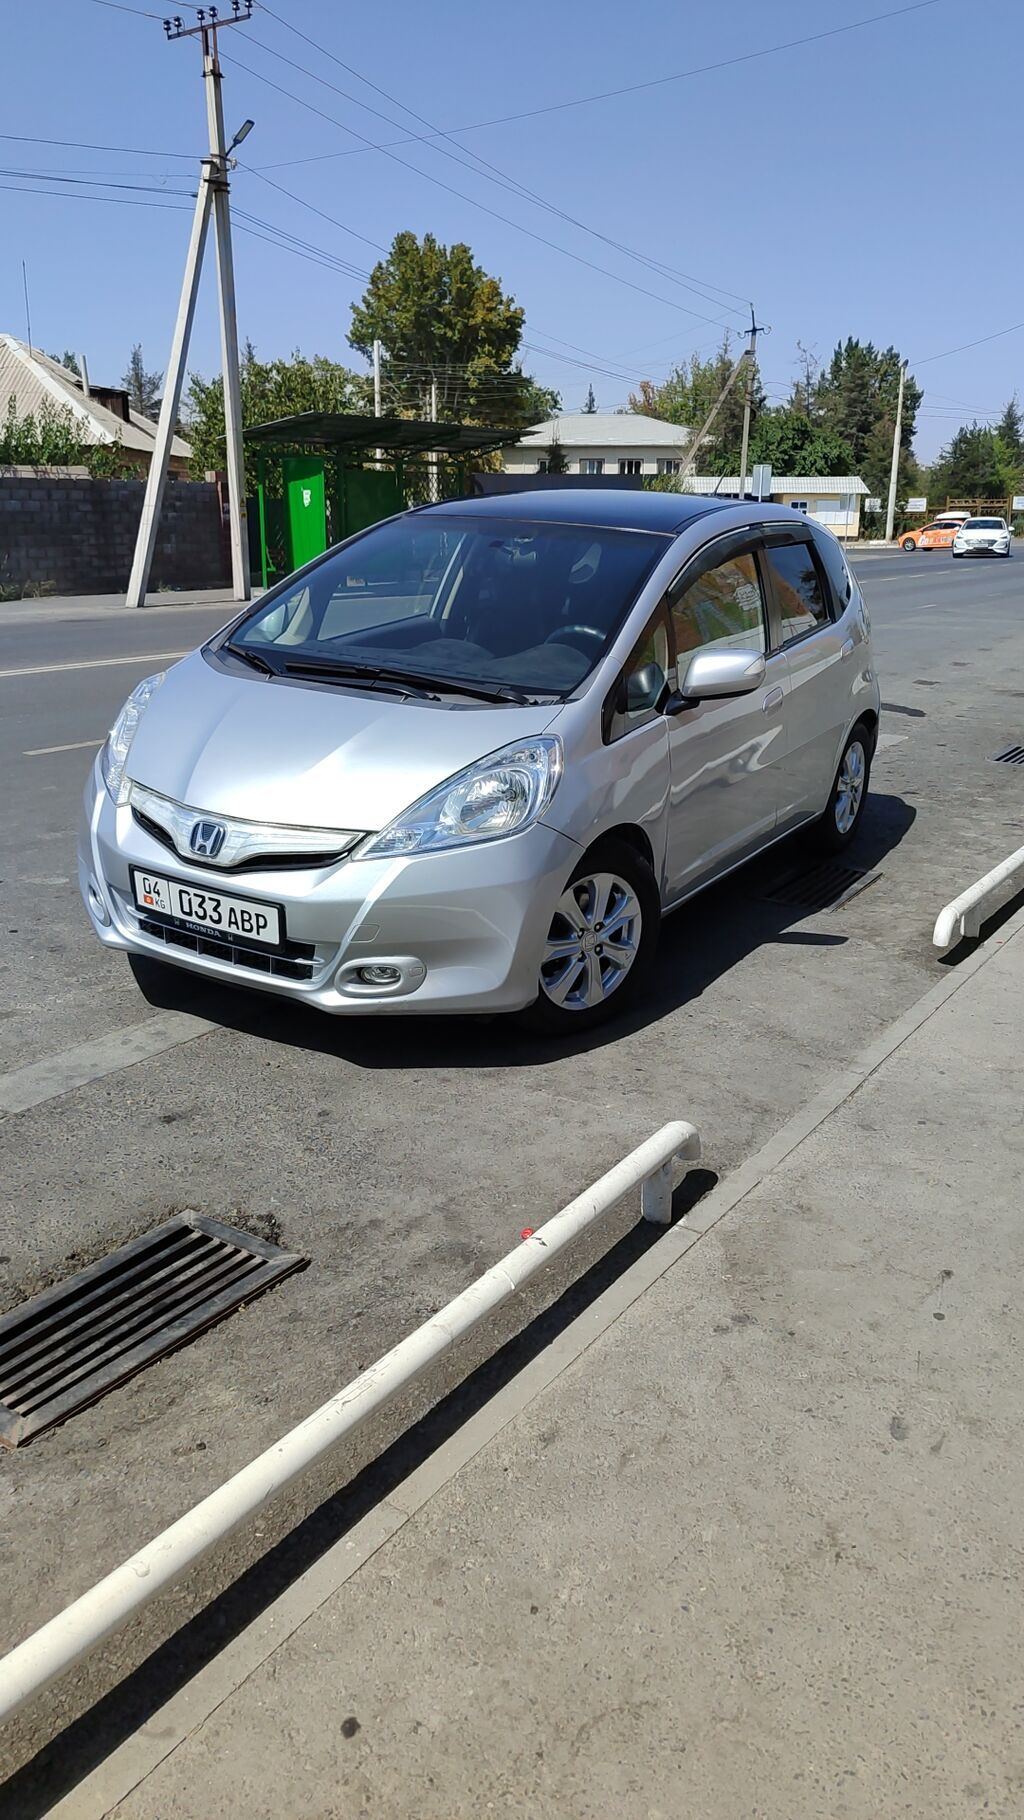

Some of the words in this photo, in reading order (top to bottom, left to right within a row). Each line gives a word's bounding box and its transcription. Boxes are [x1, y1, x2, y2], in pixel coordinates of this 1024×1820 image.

[143, 877, 161, 897] 04
[155, 898, 166, 909] KG
[178, 889, 222, 925] 033
[227, 906, 268, 936] ABP
[185, 922, 221, 937] HONDA
